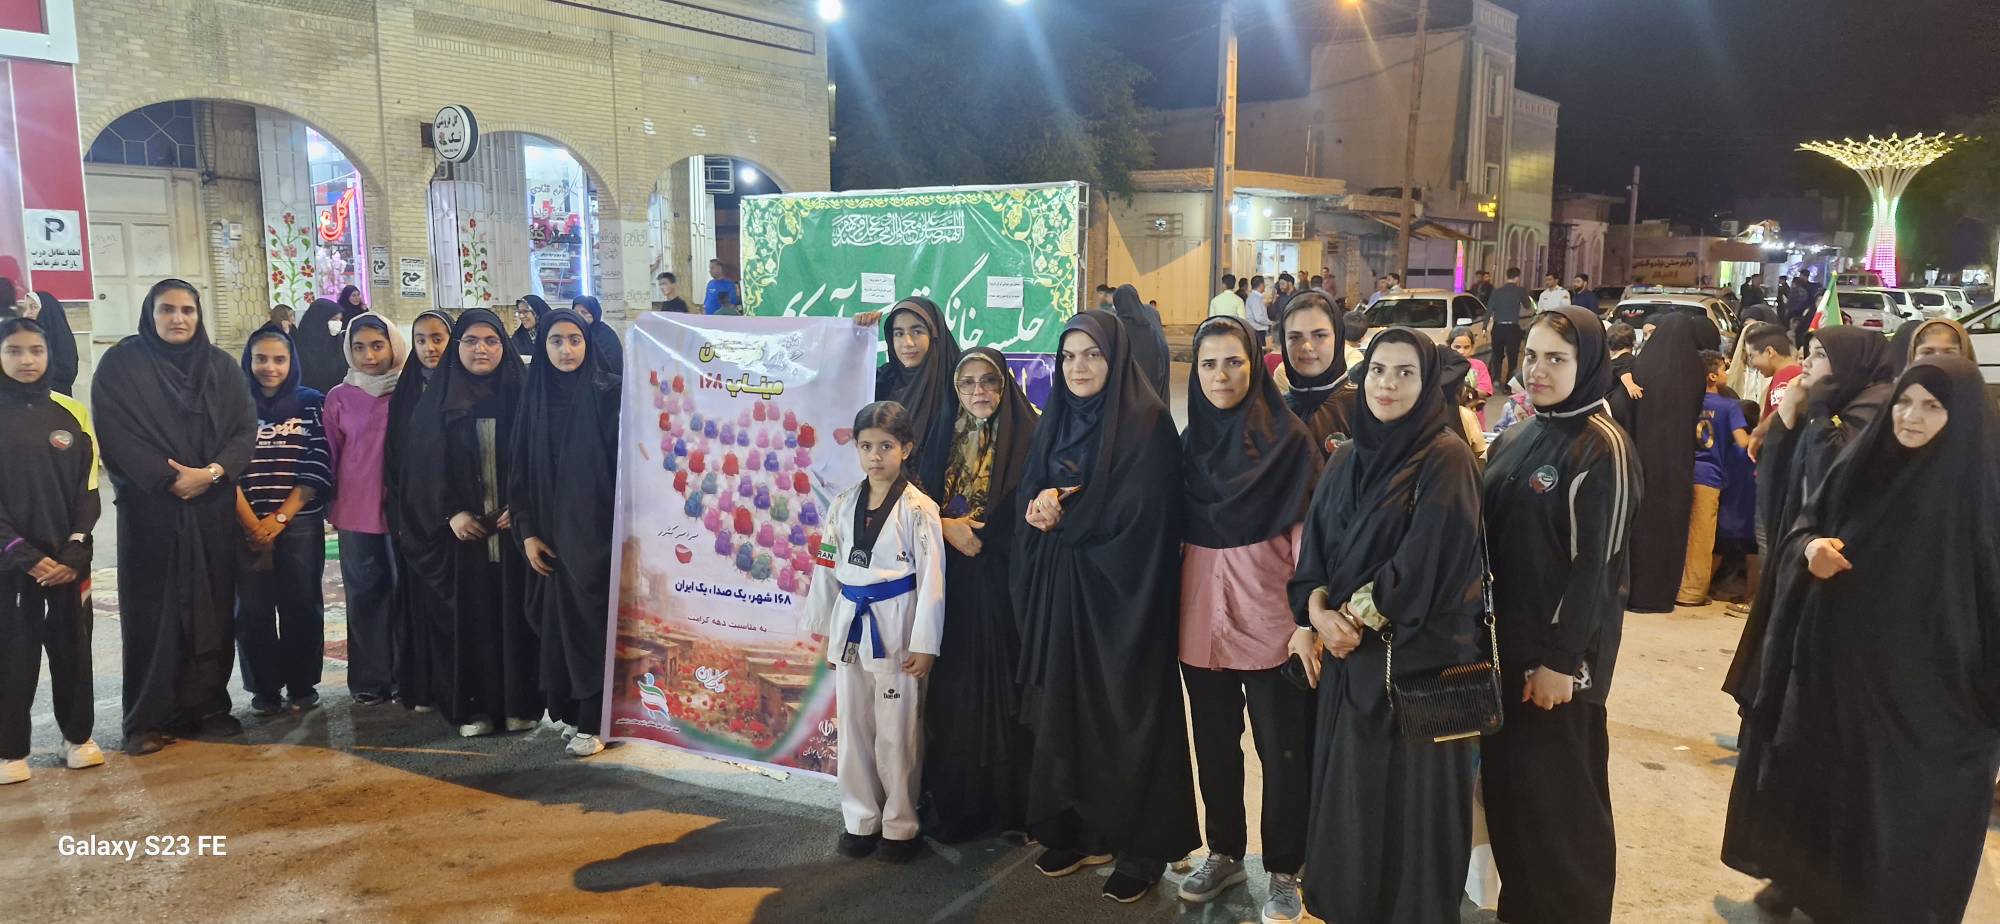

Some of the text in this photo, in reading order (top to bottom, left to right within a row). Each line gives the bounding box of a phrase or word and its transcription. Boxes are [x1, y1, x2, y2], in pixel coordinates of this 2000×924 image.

[45, 217, 65, 241] P
[987, 305, 1045, 351] جلسه
[726, 373, 784, 400] میناب
[816, 550, 834, 560] RAN
[675, 580, 694, 592] ایران
[695, 582, 708, 596] یک
[733, 588, 747, 602] یک
[774, 593, 792, 605] ۱۶۸
[687, 615, 768, 633] به مناسبت دهه کرامت
